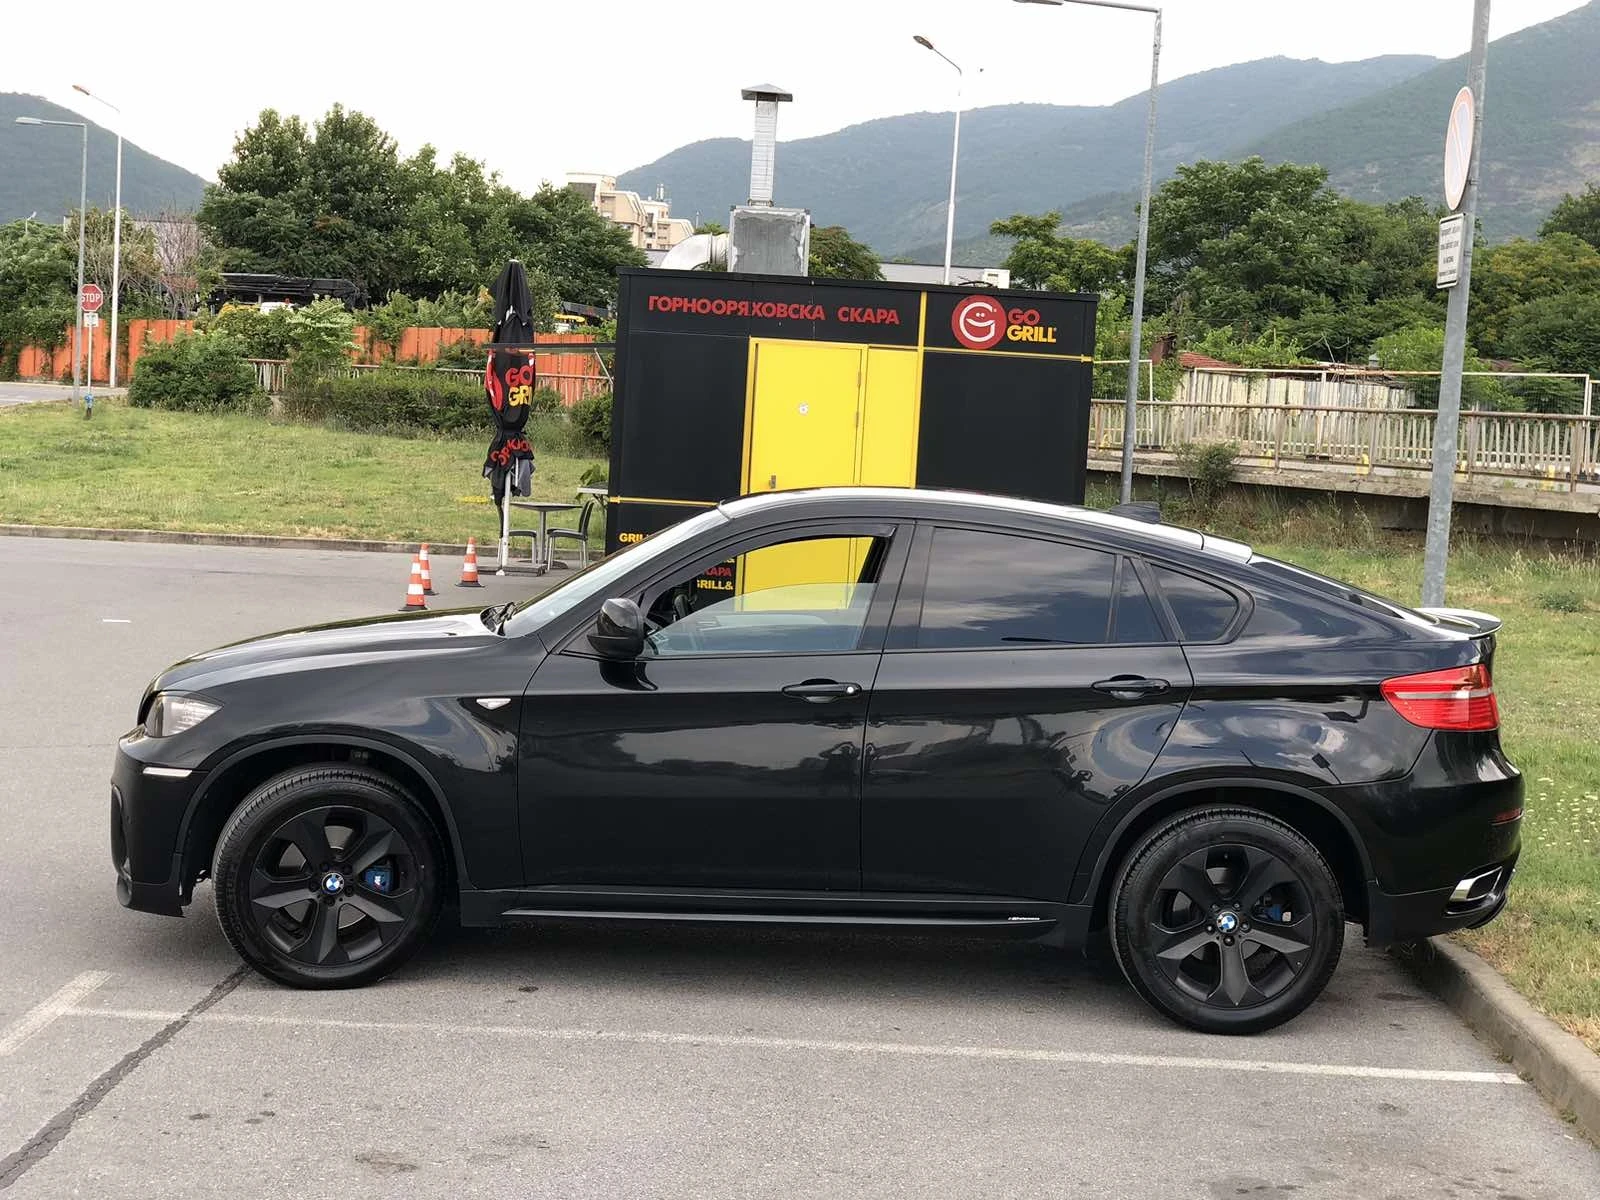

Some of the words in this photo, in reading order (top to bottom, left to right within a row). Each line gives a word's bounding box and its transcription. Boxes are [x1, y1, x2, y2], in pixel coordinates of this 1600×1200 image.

[81, 293, 100, 302] STOP
[648, 295, 826, 321] ГОРНООРЯХОВСКА
[837, 306, 900, 325] СКАРА
[1008, 308, 1040, 325] GO
[1007, 325, 1057, 343] GRILL
[697, 579, 733, 590] RILL&
